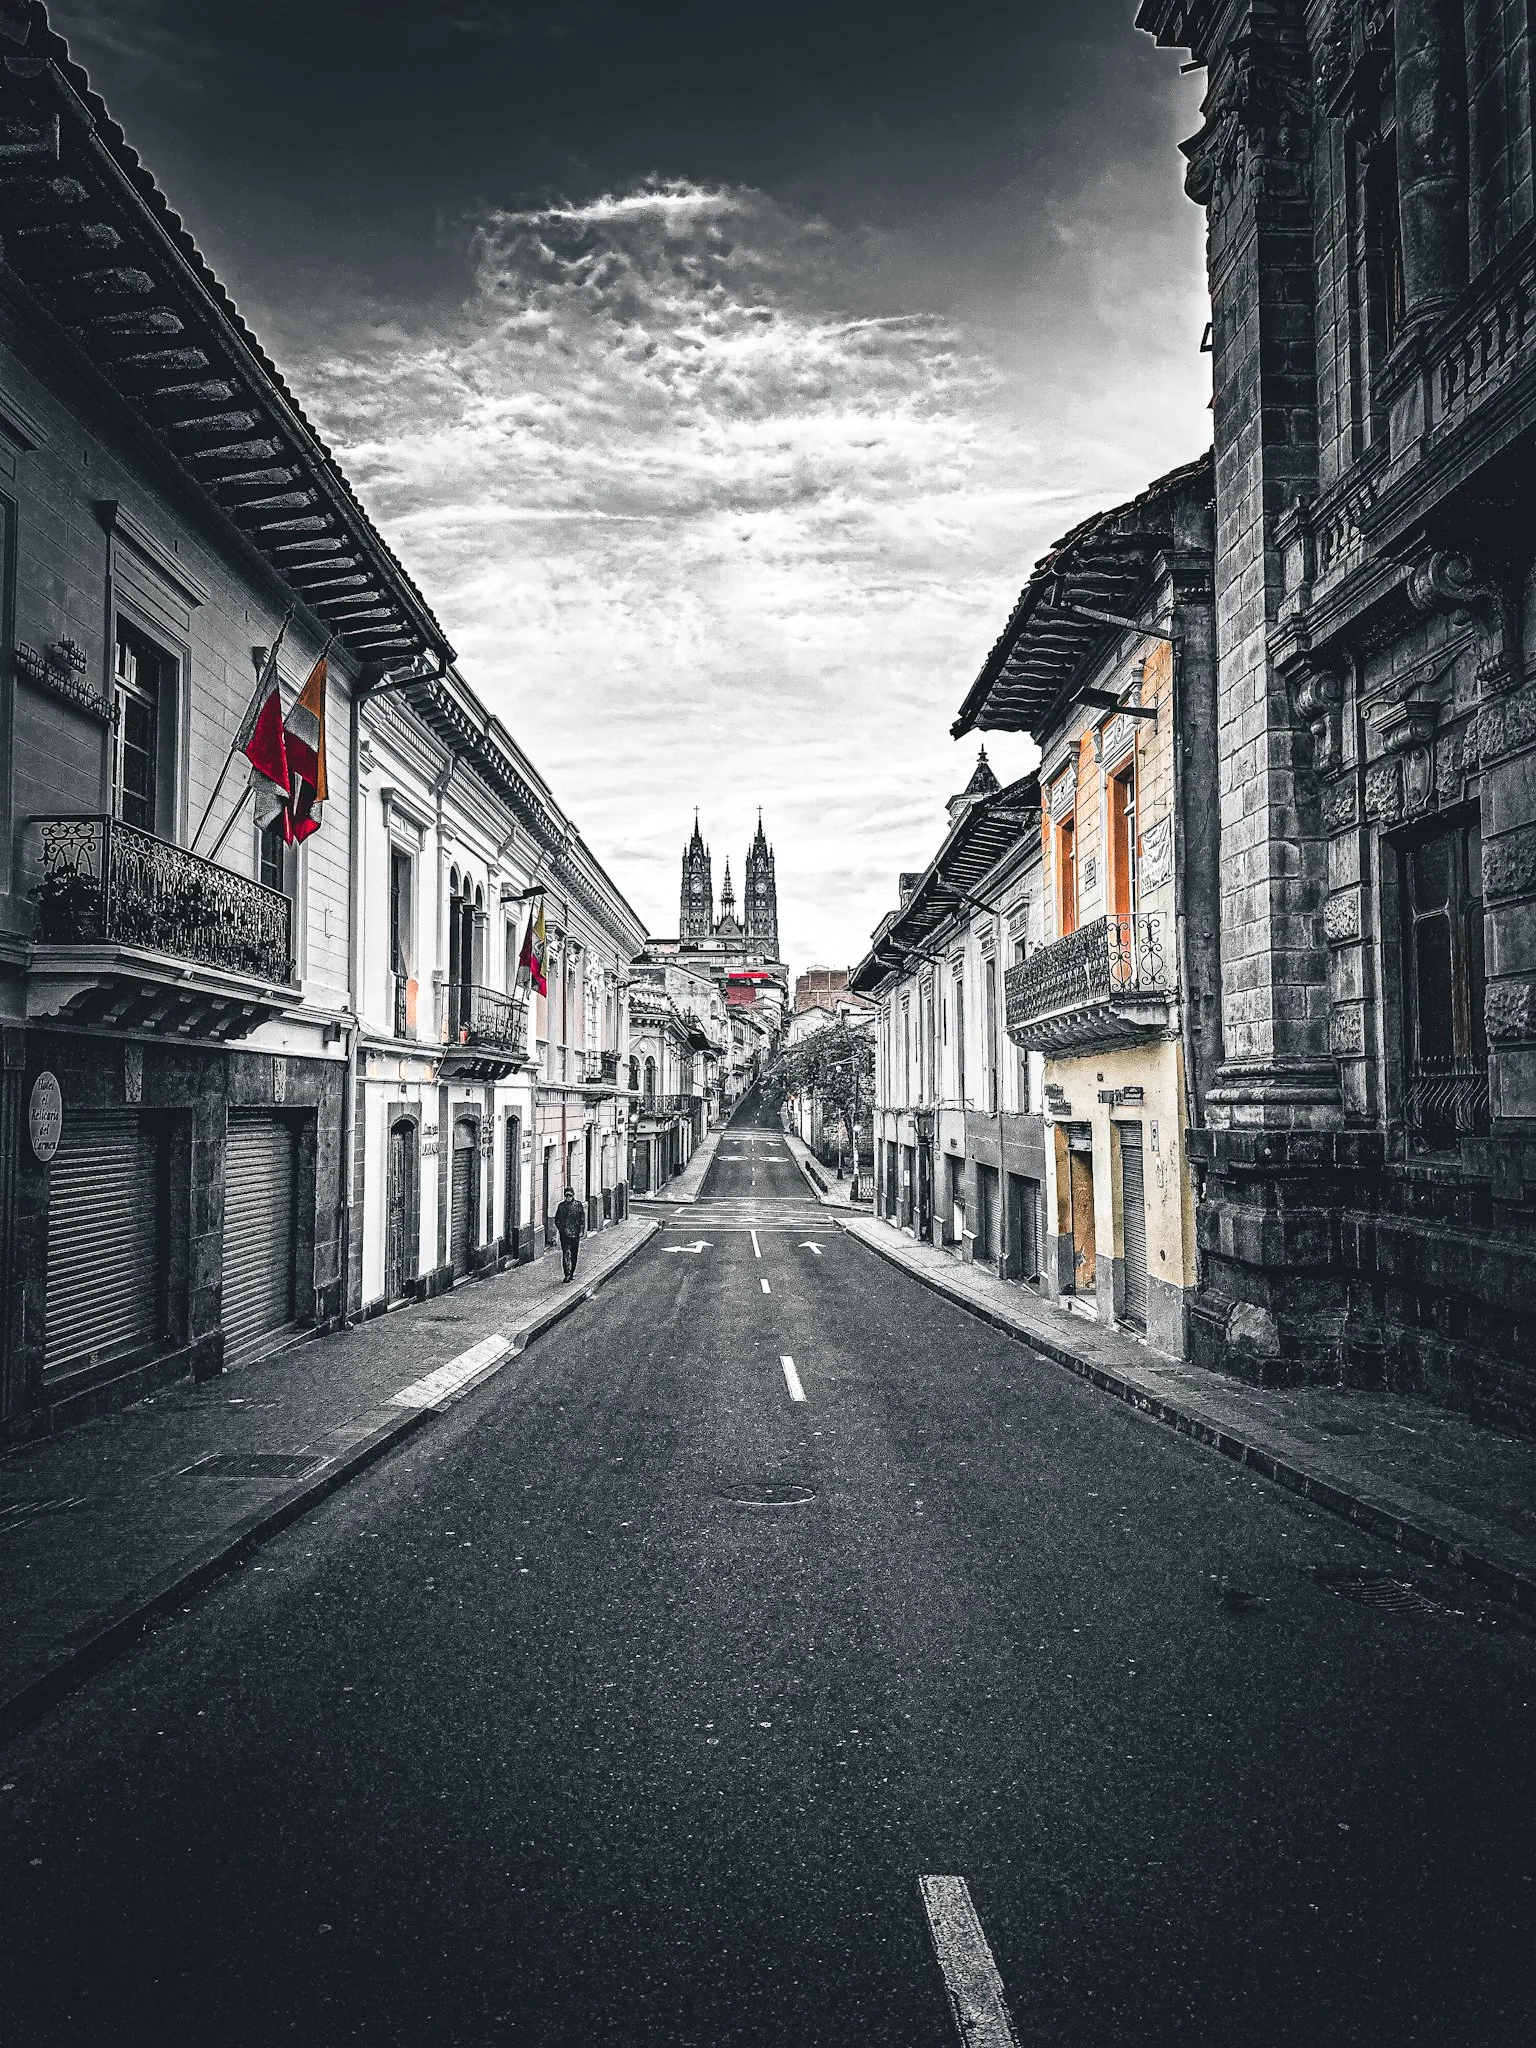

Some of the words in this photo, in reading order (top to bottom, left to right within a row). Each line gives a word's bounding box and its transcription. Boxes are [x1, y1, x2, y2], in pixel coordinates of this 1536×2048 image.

[37, 1079, 56, 1090] Hotel
[31, 1109, 59, 1120] Relicario
[40, 1124, 50, 1135] del
[34, 1138, 57, 1151] Carmen
